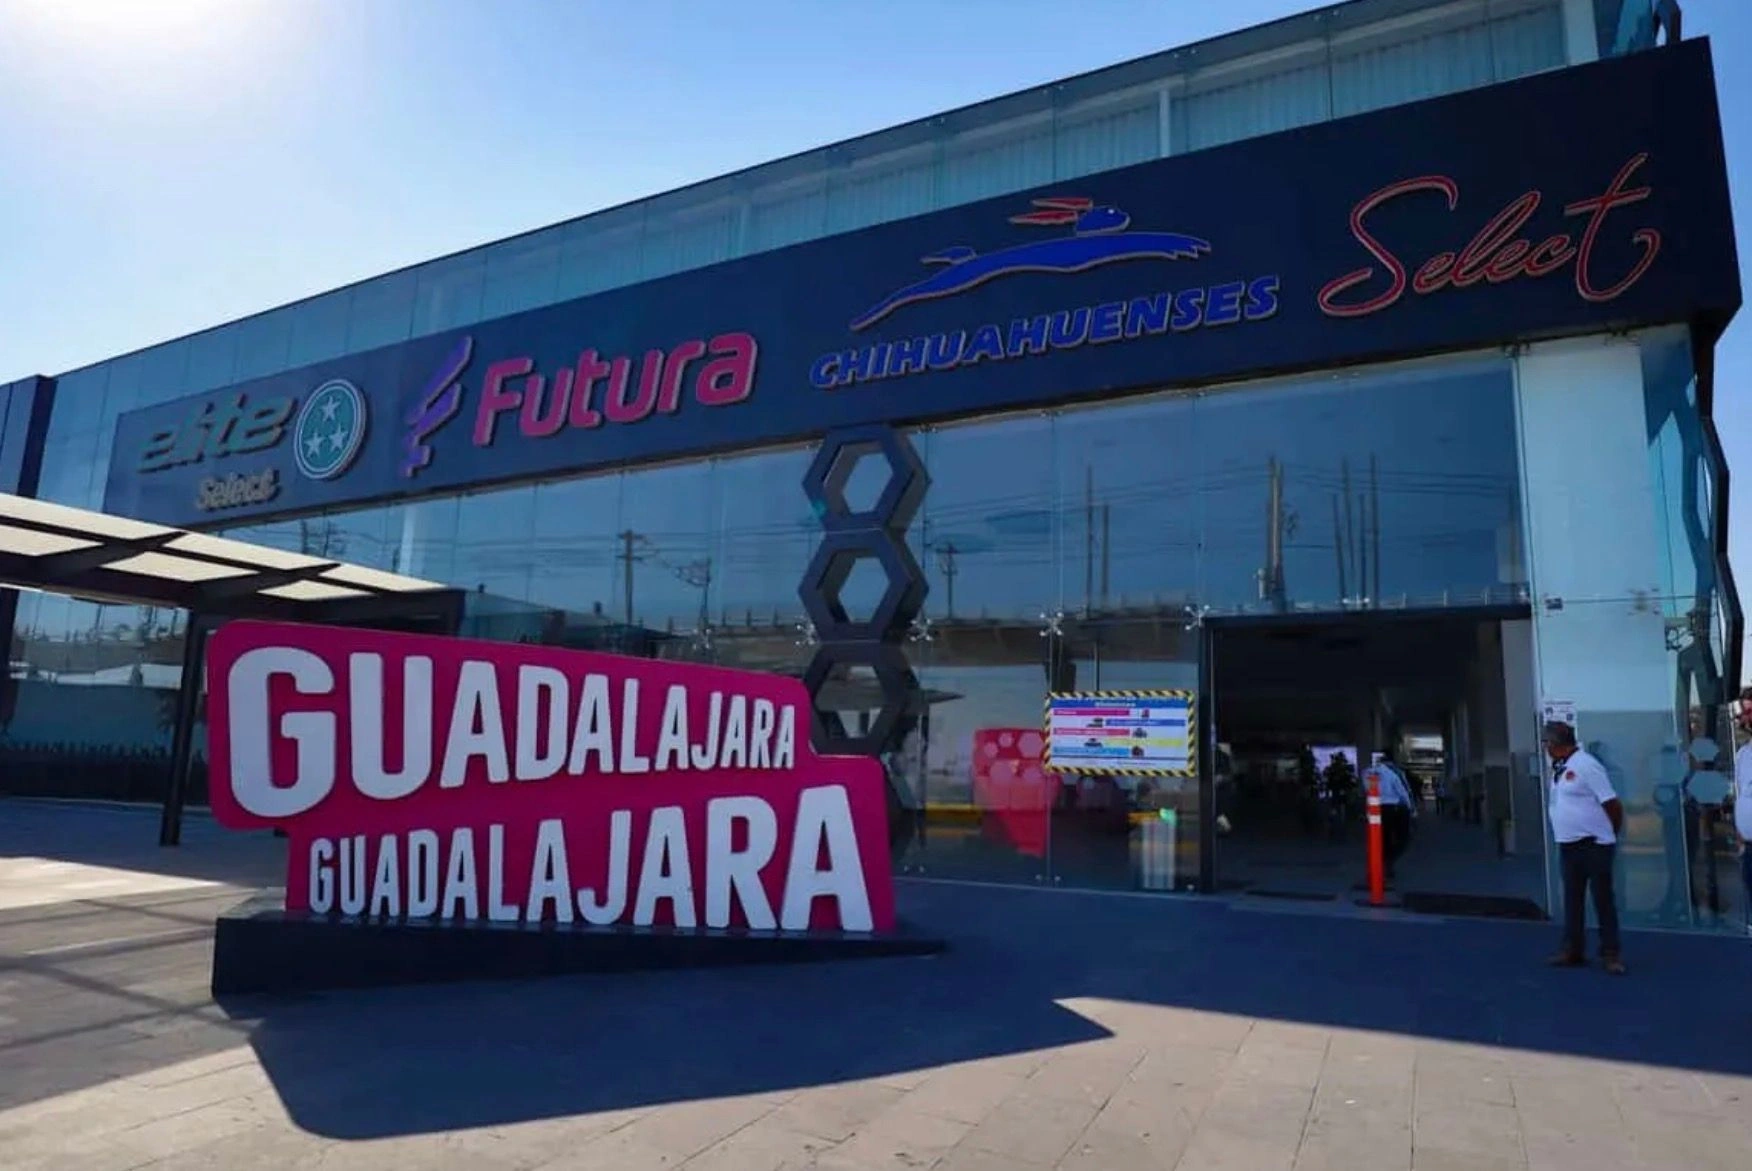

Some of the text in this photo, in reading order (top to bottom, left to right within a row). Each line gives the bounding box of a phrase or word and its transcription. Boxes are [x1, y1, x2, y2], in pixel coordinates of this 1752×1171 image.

[1318, 153, 1661, 318] Select
[473, 332, 758, 446] Futura
[809, 275, 1280, 389] CHIHUAHUENSES
[197, 468, 277, 511] Select
[228, 647, 795, 817] GUADALAJARA
[309, 785, 873, 931] GUADALAJARA
